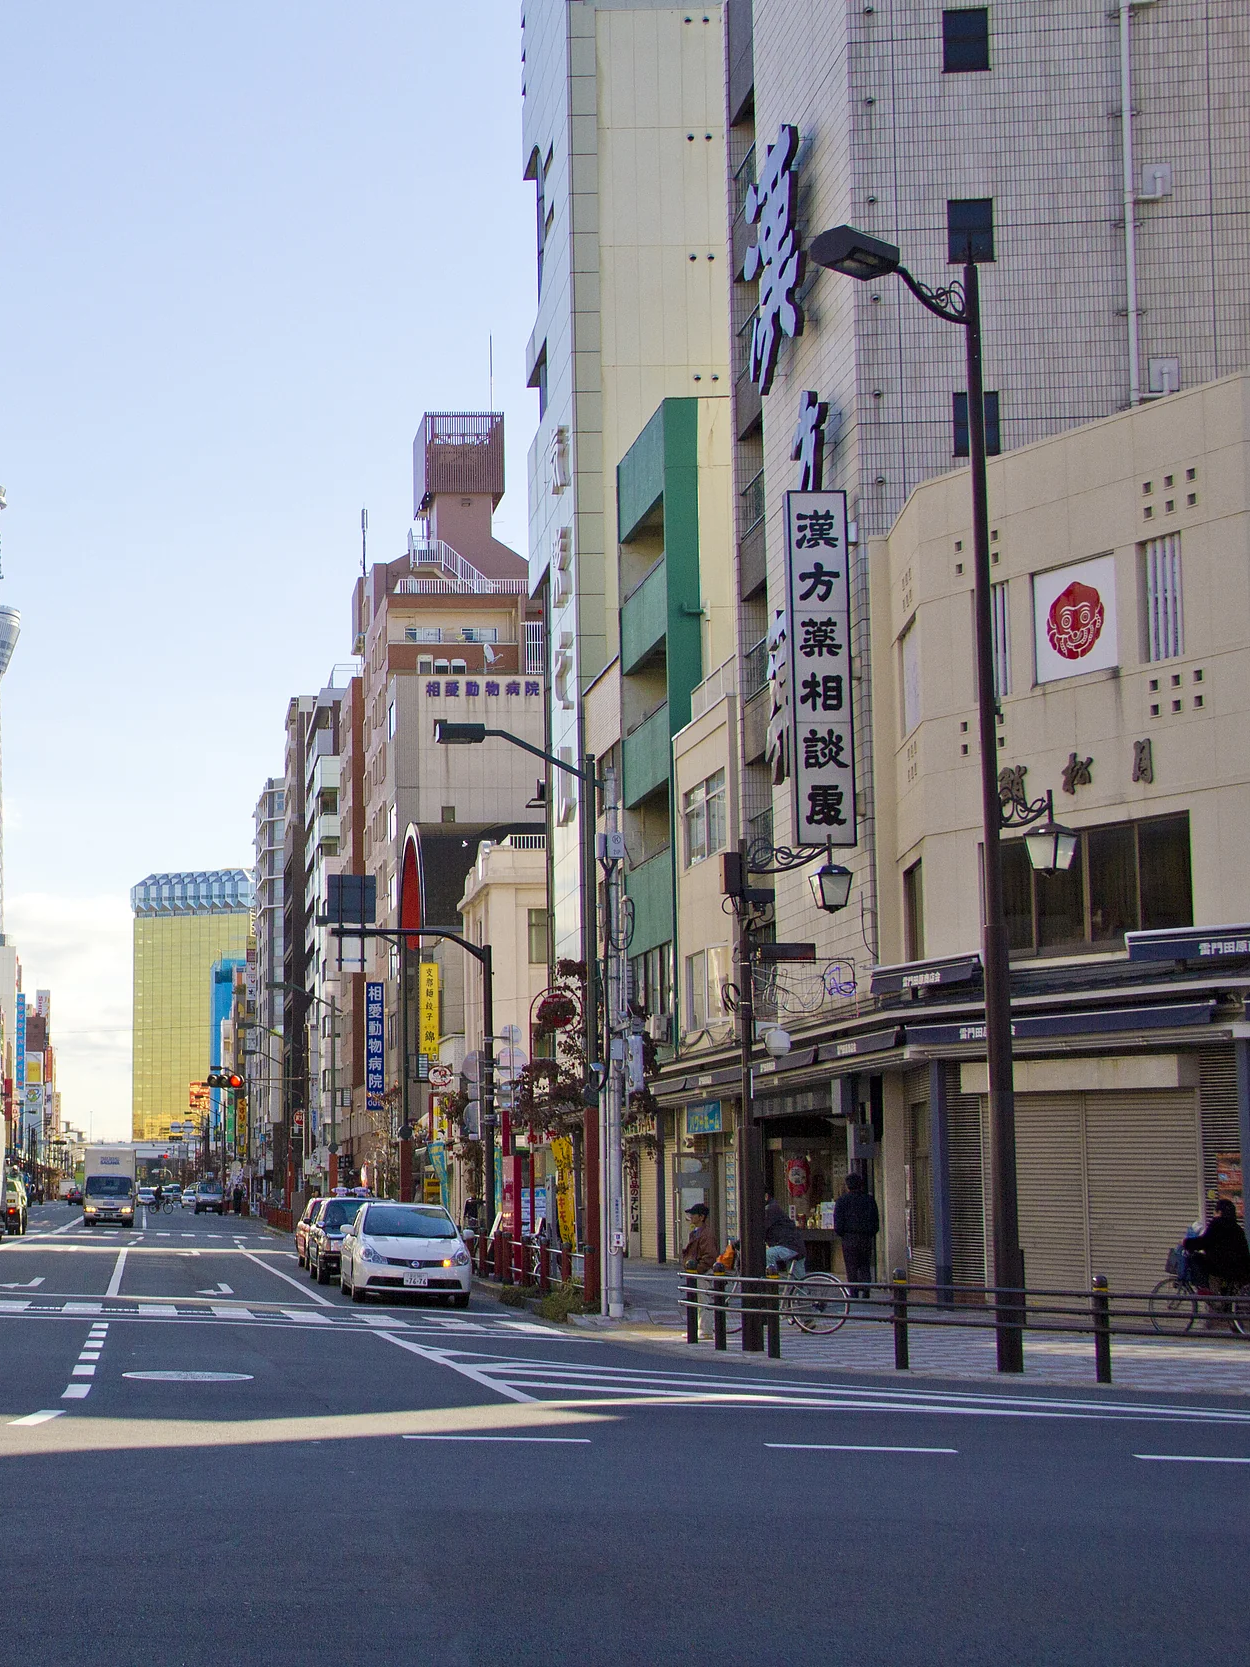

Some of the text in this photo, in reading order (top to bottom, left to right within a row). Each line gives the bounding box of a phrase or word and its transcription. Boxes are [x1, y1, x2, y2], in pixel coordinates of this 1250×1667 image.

[425, 680, 540, 698] 相愛動物病院
[1198, 940, 1250, 956] 雷門田原
[367, 985, 383, 1089] 相愛動物病院
